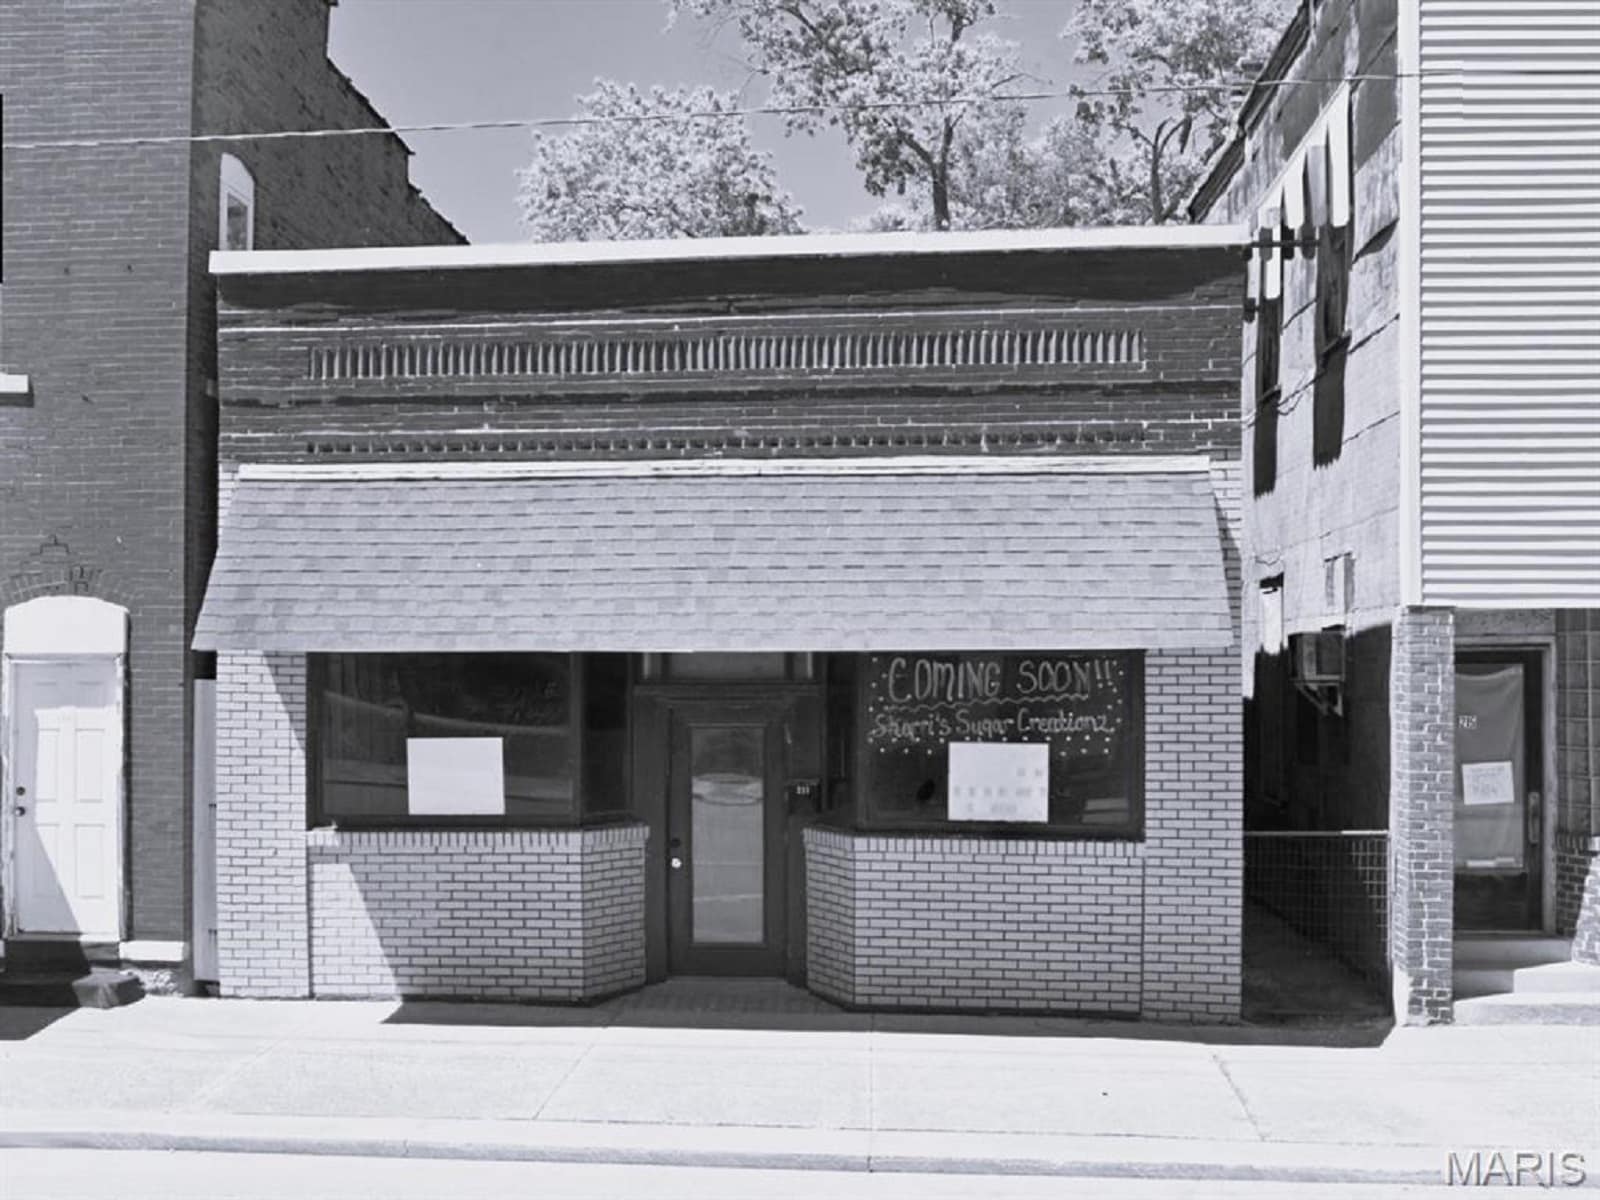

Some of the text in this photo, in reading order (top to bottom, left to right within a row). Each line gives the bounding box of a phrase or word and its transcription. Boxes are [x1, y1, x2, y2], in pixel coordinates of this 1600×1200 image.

[888, 657, 1113, 702] COMING SOON!!
[956, 708, 1015, 739] Sugar
[1017, 707, 1115, 733] Creationz
